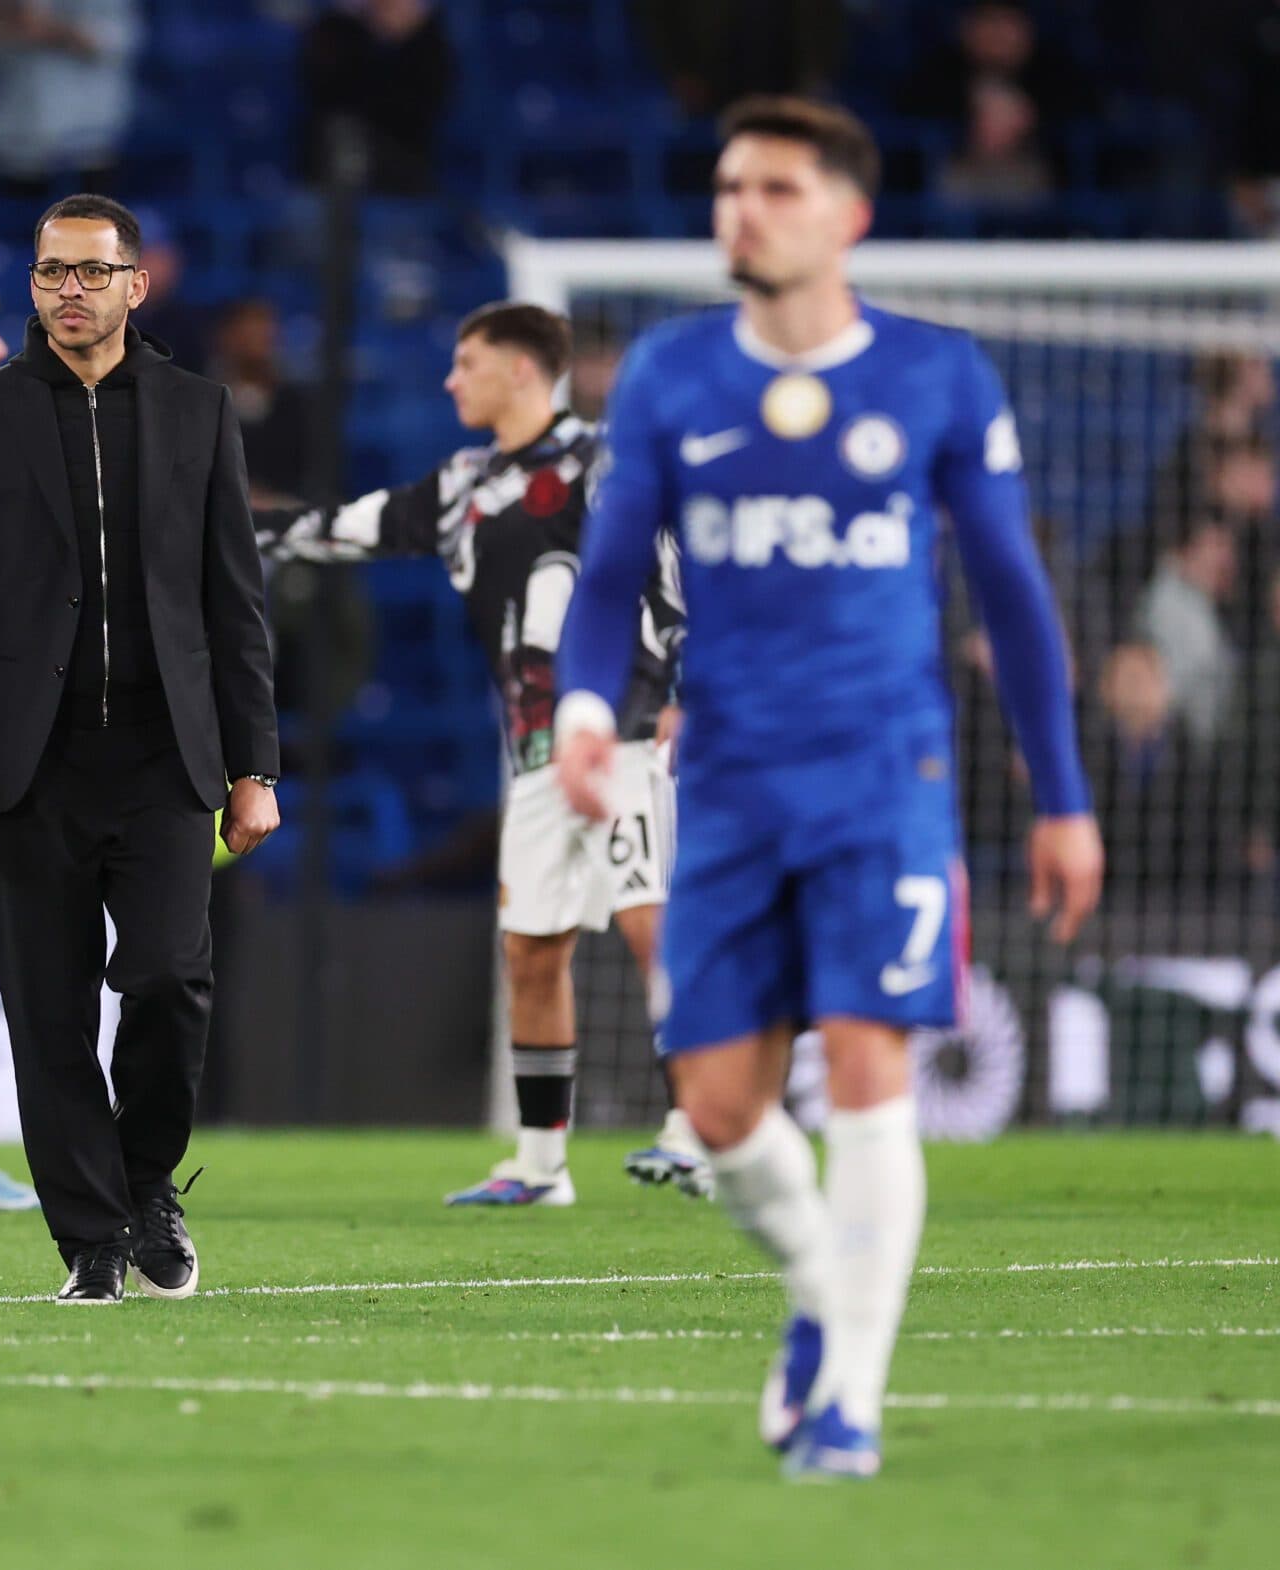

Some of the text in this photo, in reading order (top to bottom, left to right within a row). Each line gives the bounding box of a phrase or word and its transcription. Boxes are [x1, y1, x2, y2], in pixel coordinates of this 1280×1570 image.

[730, 489, 916, 569] IFS.ai
[607, 814, 652, 867] 61
[893, 873, 948, 966] 7
